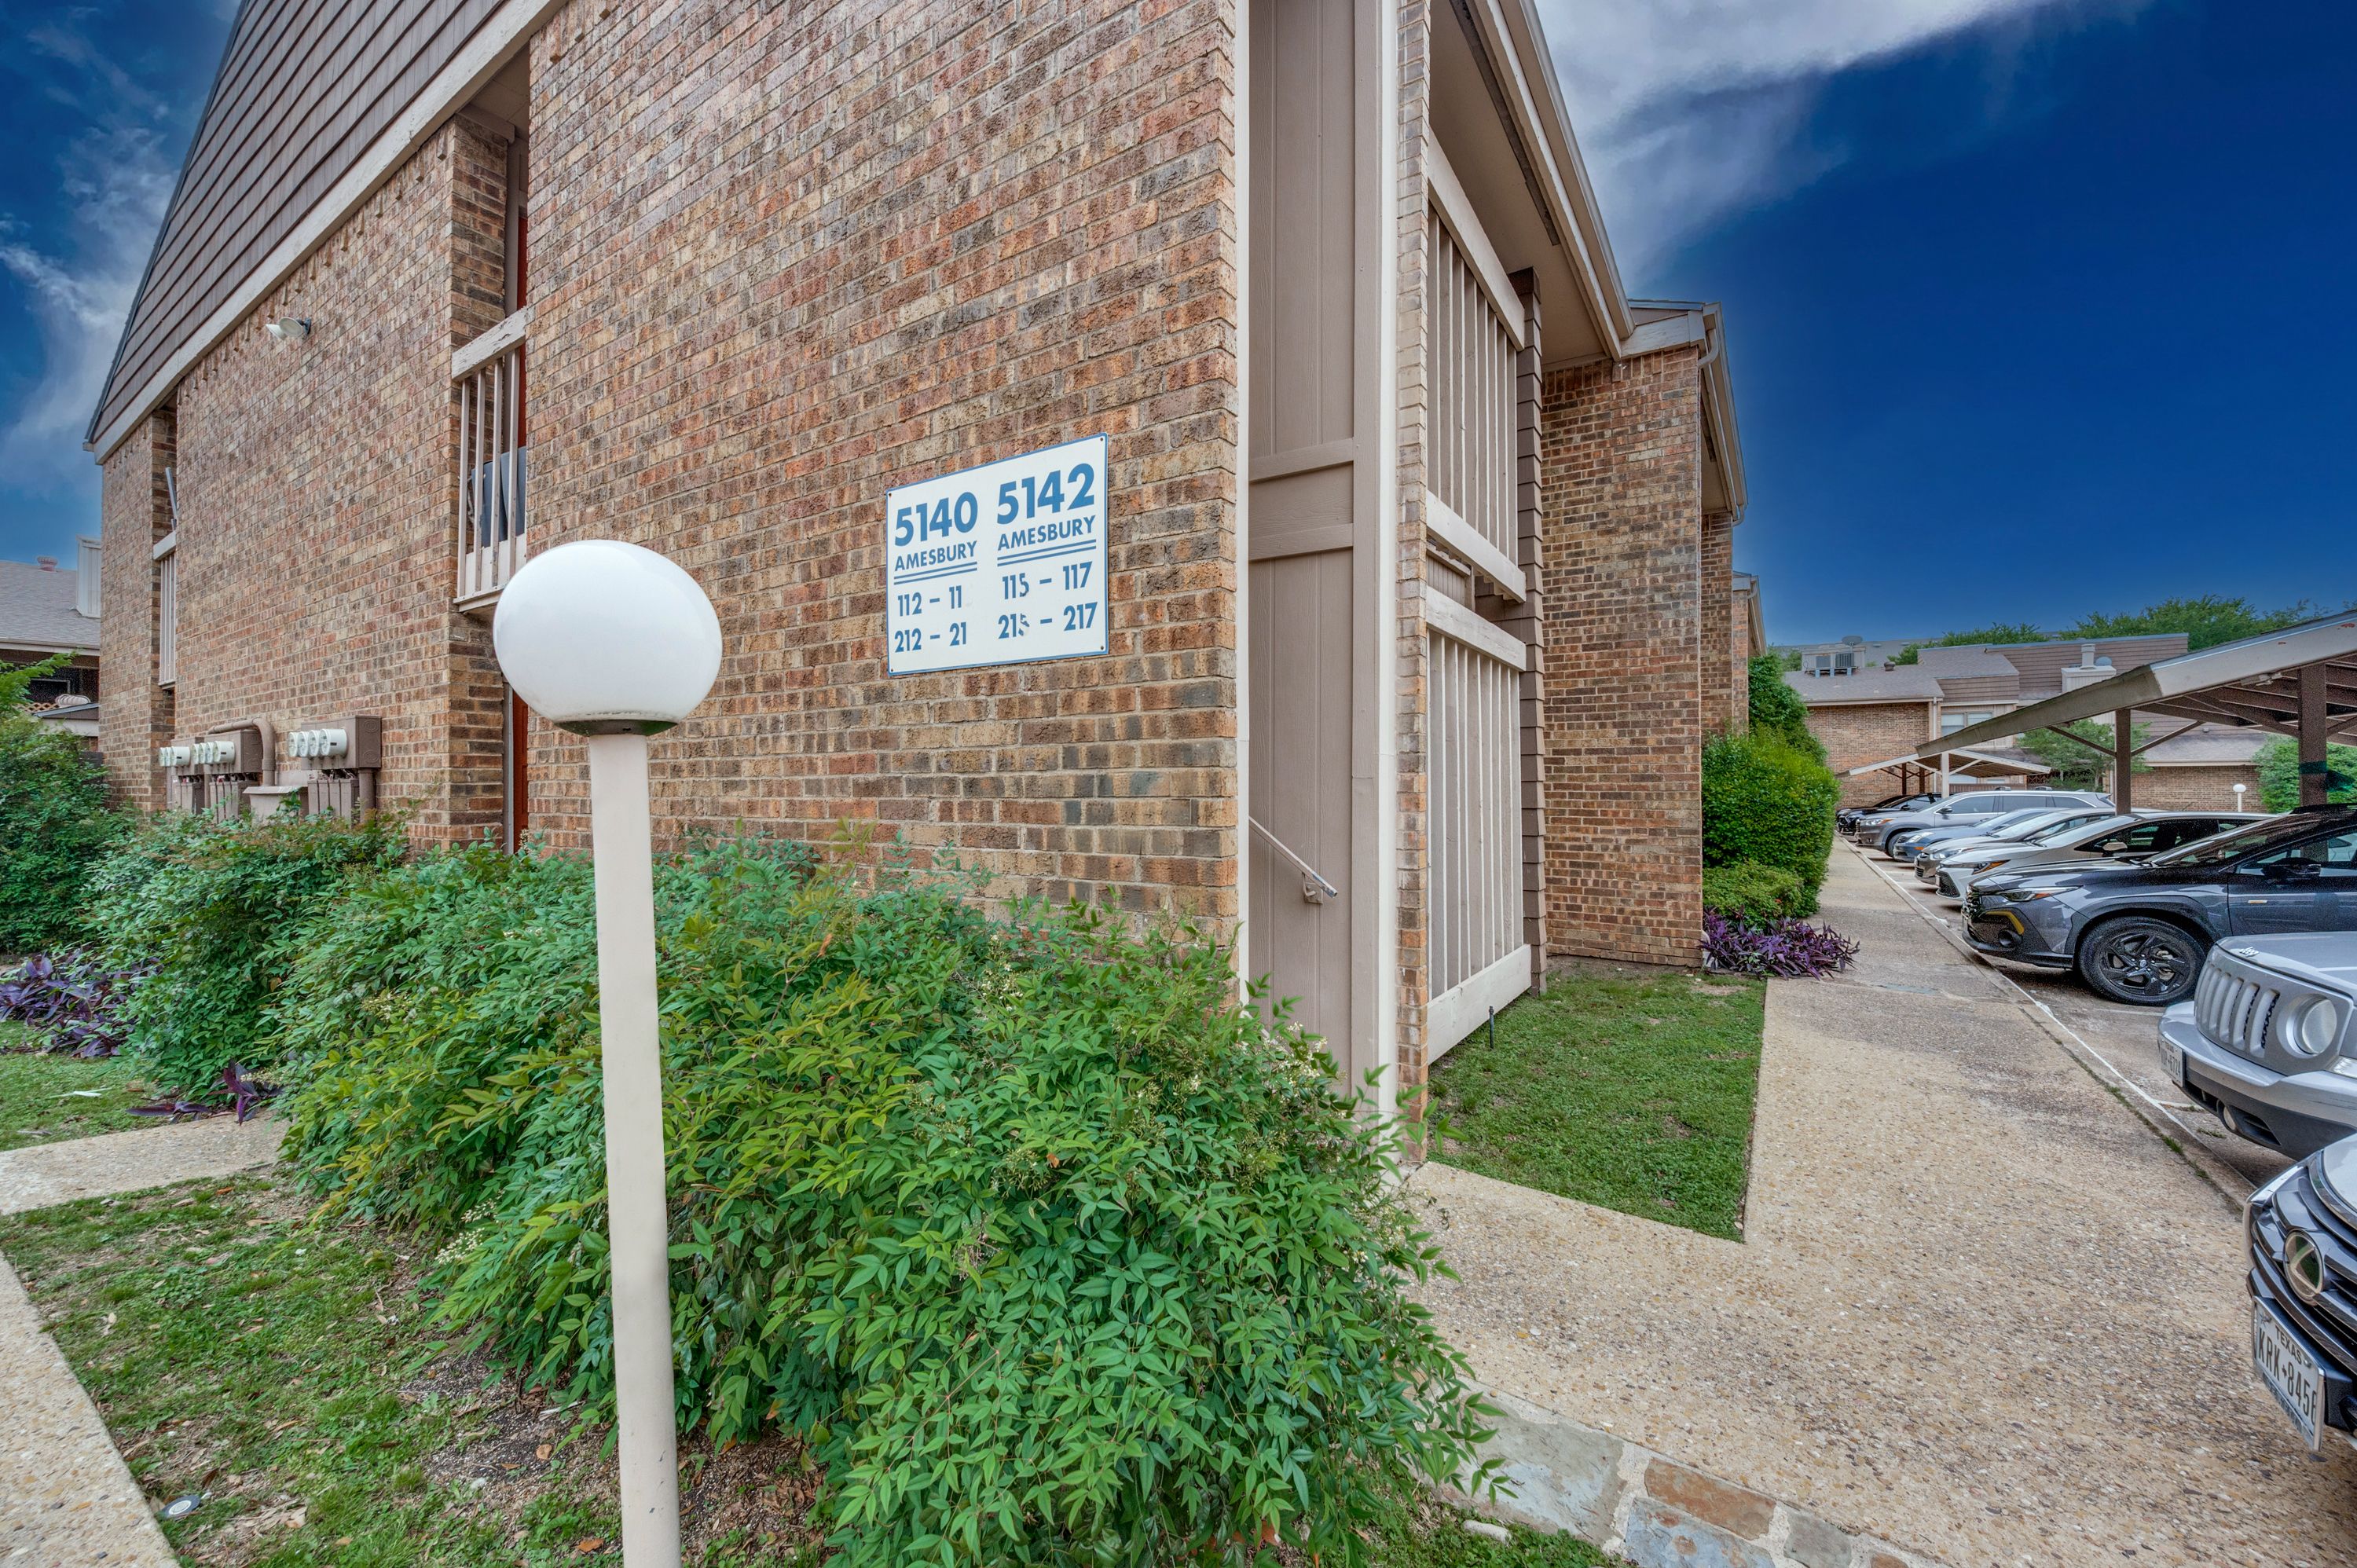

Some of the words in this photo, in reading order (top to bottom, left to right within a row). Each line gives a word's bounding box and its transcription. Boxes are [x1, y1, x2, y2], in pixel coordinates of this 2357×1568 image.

[996, 463, 1095, 526] 5142
[894, 492, 979, 548] 5140
[998, 515, 1096, 551] AMESBURY
[894, 540, 978, 572] AMESBURY
[1002, 572, 1030, 600] 115
[1062, 561, 1093, 591] 117
[897, 592, 922, 617] 112
[948, 584, 962, 610] 11
[1063, 602, 1098, 632] 217
[894, 628, 922, 654] 212
[949, 621, 967, 647] 21
[2275, 1324, 2303, 1365] TEXAS
